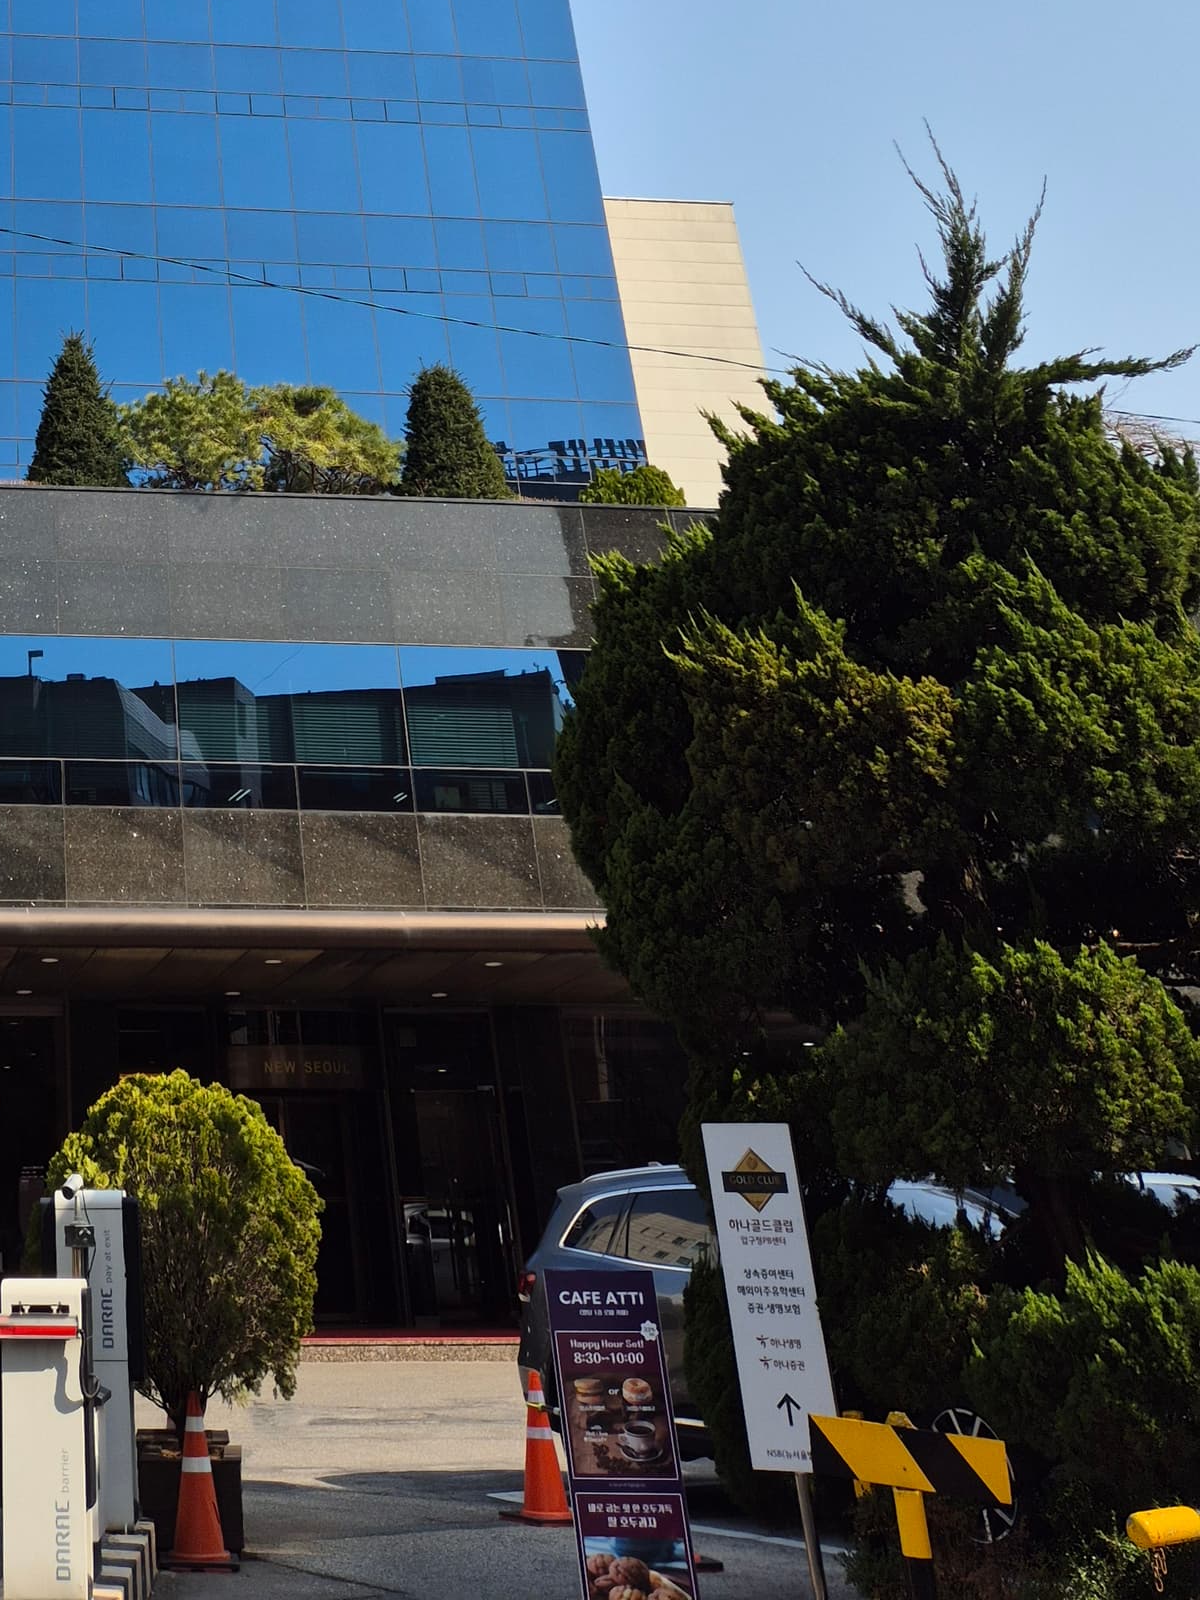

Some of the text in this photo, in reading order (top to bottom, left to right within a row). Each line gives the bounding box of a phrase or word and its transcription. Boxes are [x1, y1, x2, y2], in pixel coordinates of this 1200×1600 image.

[264, 1061, 351, 1074] NEW SEOUL
[729, 1219, 794, 1233] 하나골드클럽
[104, 1251, 111, 1262] at
[105, 1265, 113, 1284] pay
[743, 1268, 794, 1280] 상속증여센터
[559, 1291, 644, 1305] CAFE ATTI
[101, 1287, 114, 1349] DARAE
[570, 1339, 600, 1350] Happy
[601, 1339, 624, 1349] Hour
[608, 1388, 620, 1396] or
[55, 1448, 71, 1581] DARAE barrier
